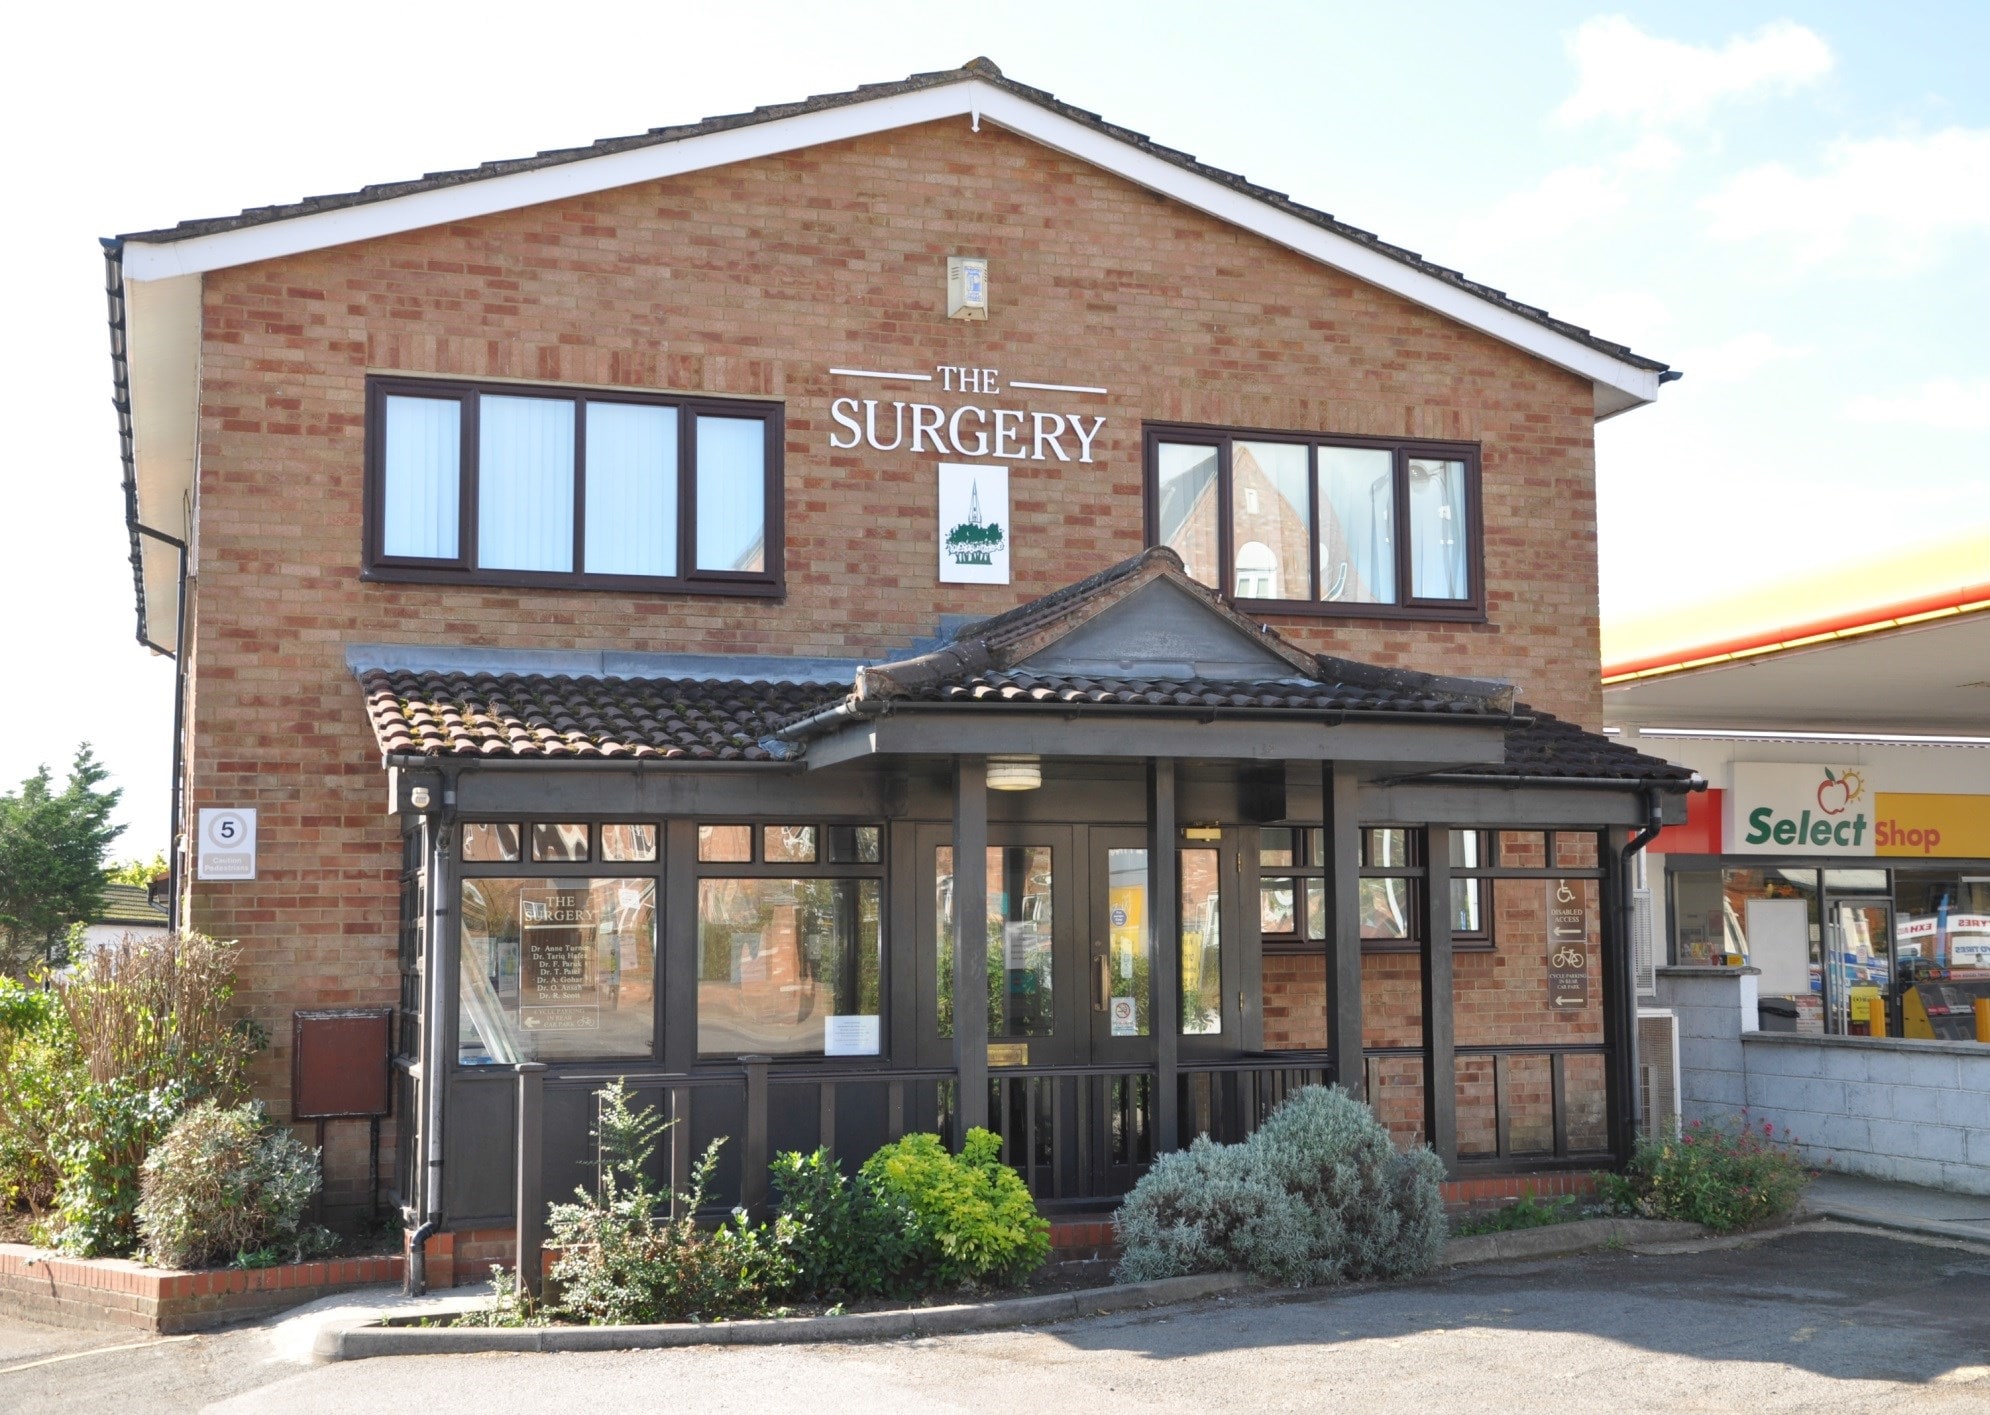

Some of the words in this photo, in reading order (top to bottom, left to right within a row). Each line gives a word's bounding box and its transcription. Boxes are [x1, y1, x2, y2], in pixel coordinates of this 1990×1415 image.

[936, 365, 1000, 394] THE
[830, 398, 1106, 463] SURGERY
[221, 821, 235, 838] 5
[1745, 807, 1867, 846] Select
[1875, 819, 1941, 853] Shop
[545, 896, 575, 908] THE
[525, 909, 595, 922] SURGERY
[1551, 908, 1583, 916] DISABLED
